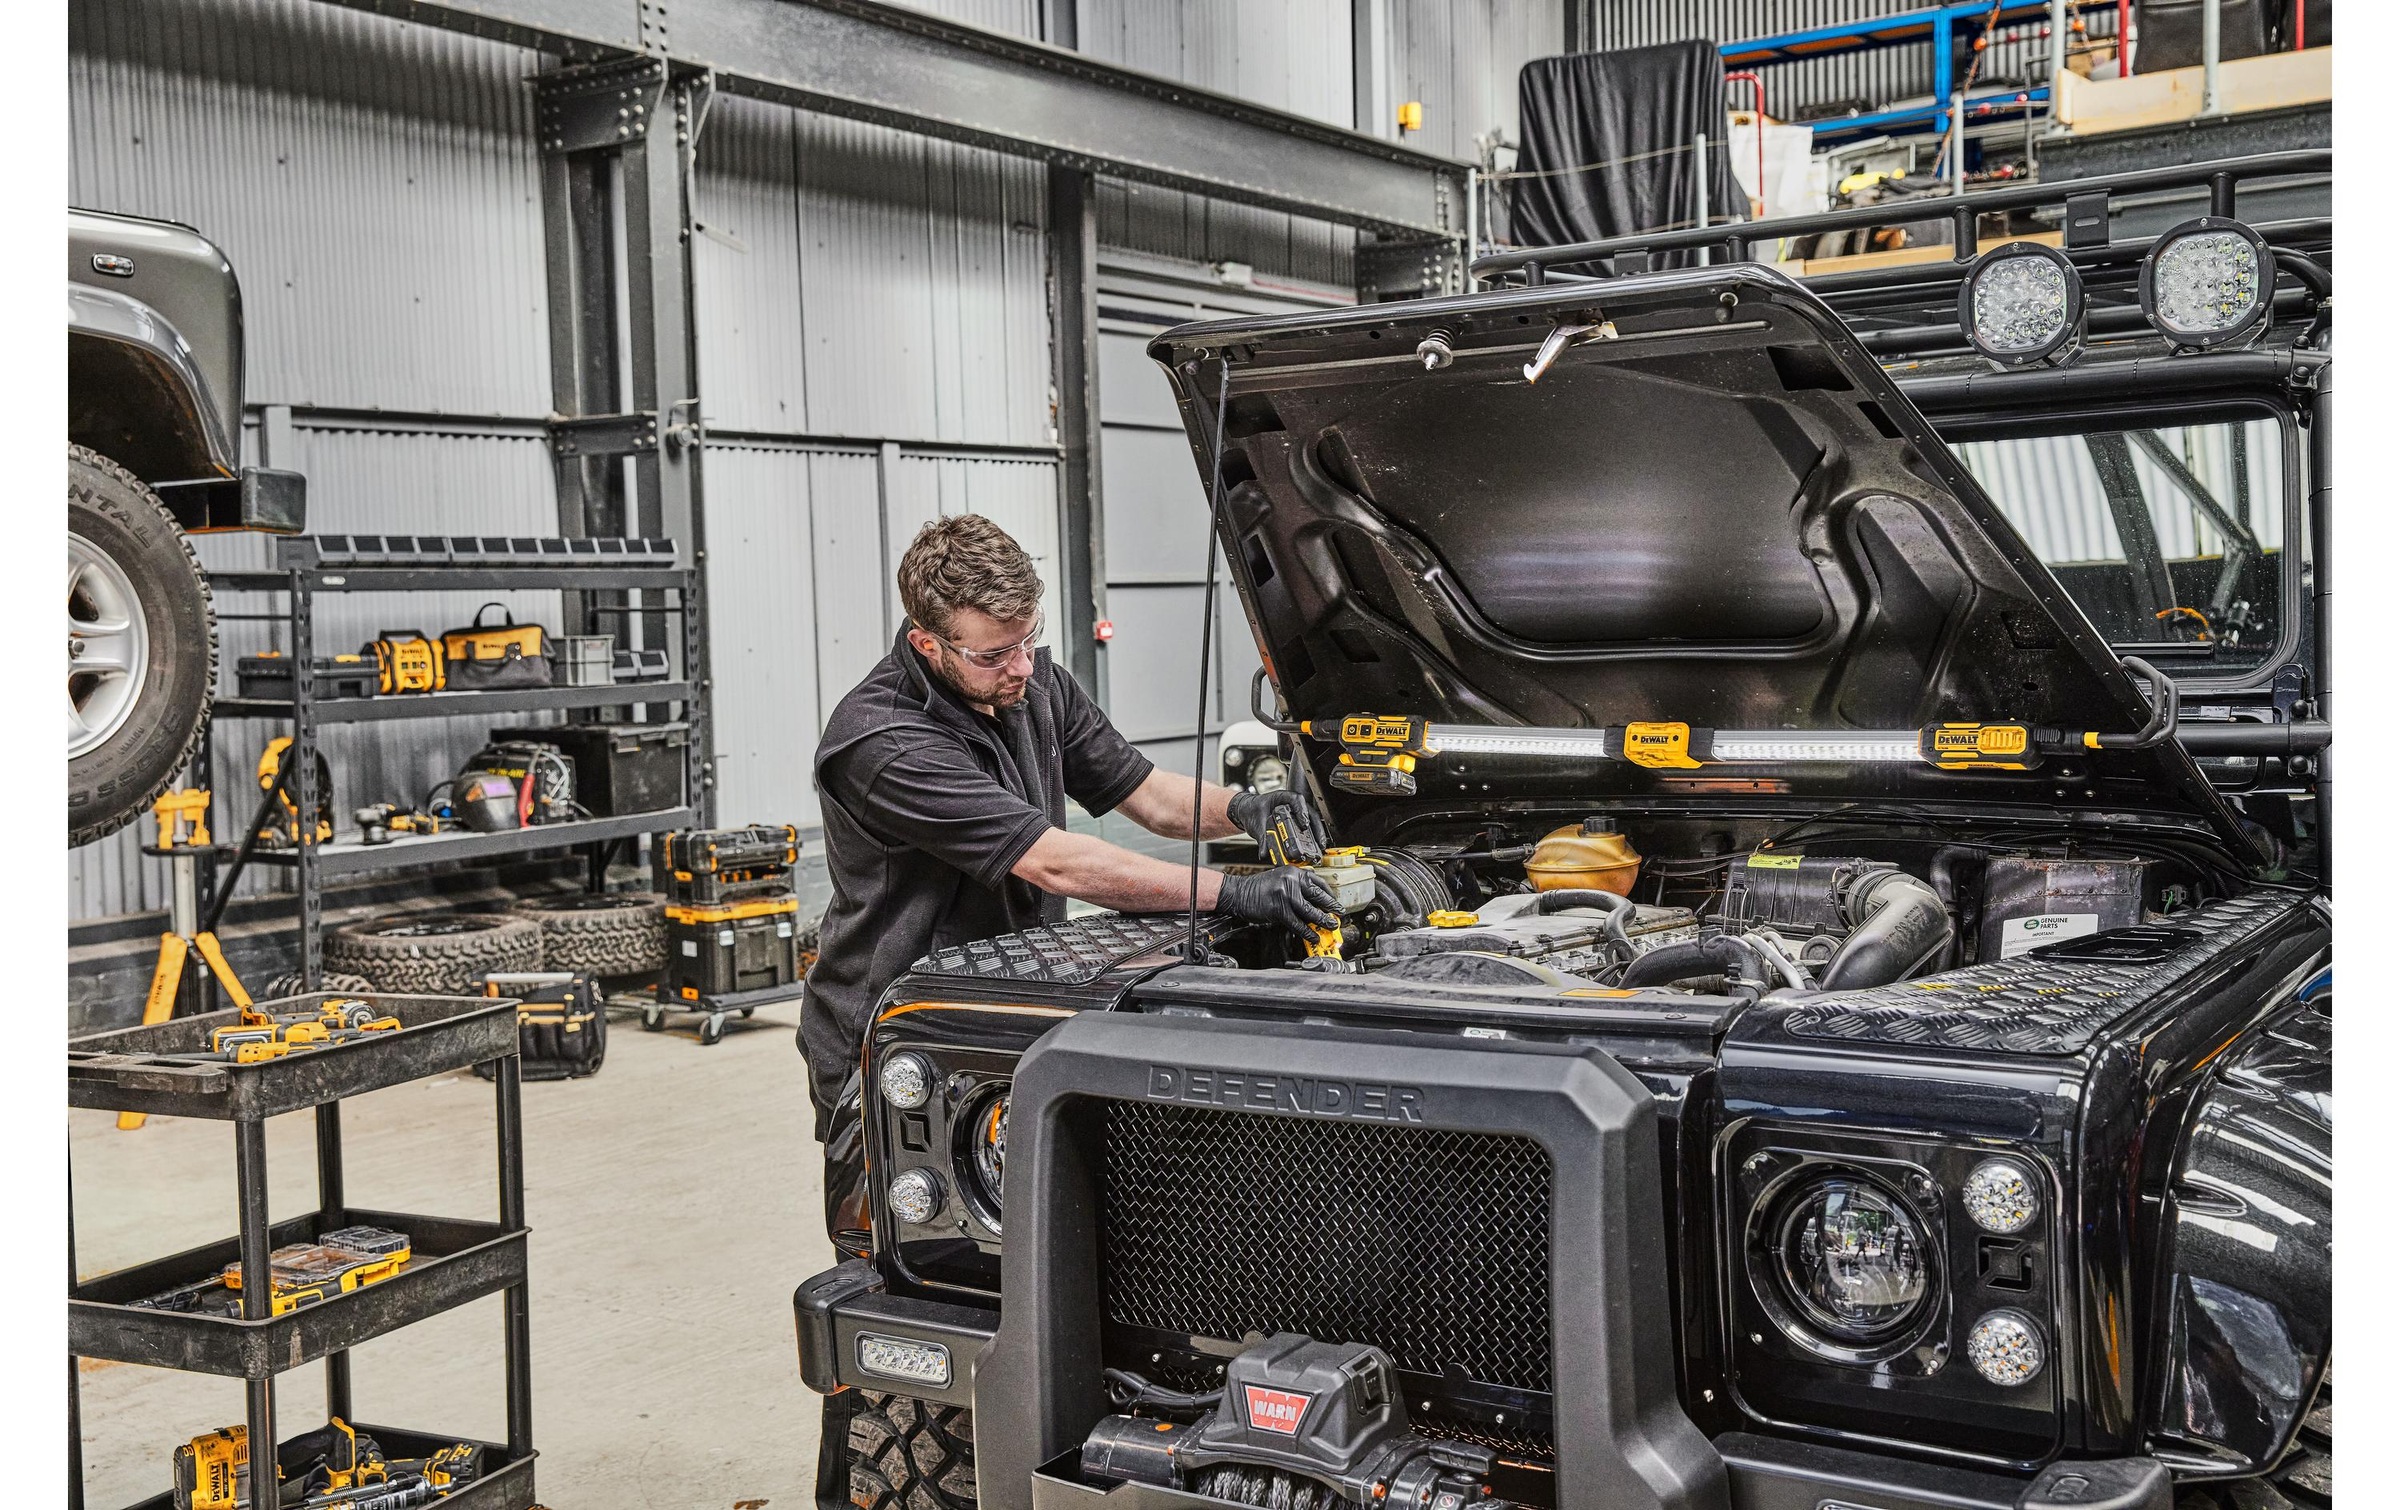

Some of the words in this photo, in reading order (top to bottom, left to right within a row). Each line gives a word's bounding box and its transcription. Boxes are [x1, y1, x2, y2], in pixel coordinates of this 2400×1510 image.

[1376, 727, 1407, 735] DEWALT
[1641, 735, 1669, 744] DEWALT
[1938, 735, 1979, 745] DEWALT
[1146, 1064, 1425, 1123] DEFENDER
[1254, 1399, 1297, 1422] WARN
[211, 1464, 220, 1502] DEWALT
